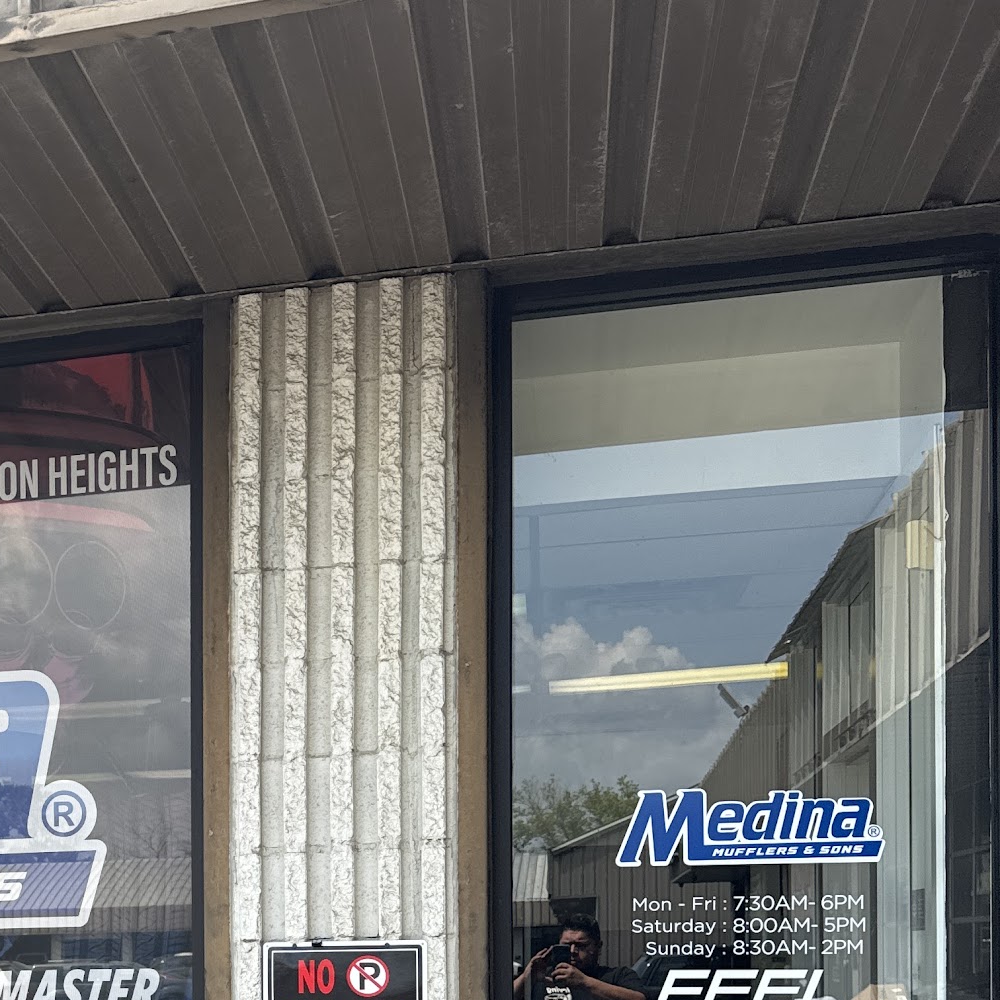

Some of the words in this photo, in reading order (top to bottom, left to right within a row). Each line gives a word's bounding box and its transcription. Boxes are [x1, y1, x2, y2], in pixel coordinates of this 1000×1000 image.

[48, 444, 178, 496] HEIGHTS
[615, 789, 874, 867] Medina
[712, 846, 798, 856] MUFFLERS
[803, 845, 814, 854] &
[818, 844, 864, 855] SONS
[632, 898, 672, 911] Mon
[692, 897, 716, 911] Fri
[821, 895, 864, 910] 6PM
[632, 919, 716, 935] Saturday
[823, 917, 866, 932] 5PM
[646, 941, 715, 958] Sunday
[821, 940, 863, 955] 2PM
[297, 958, 335, 994] NO
